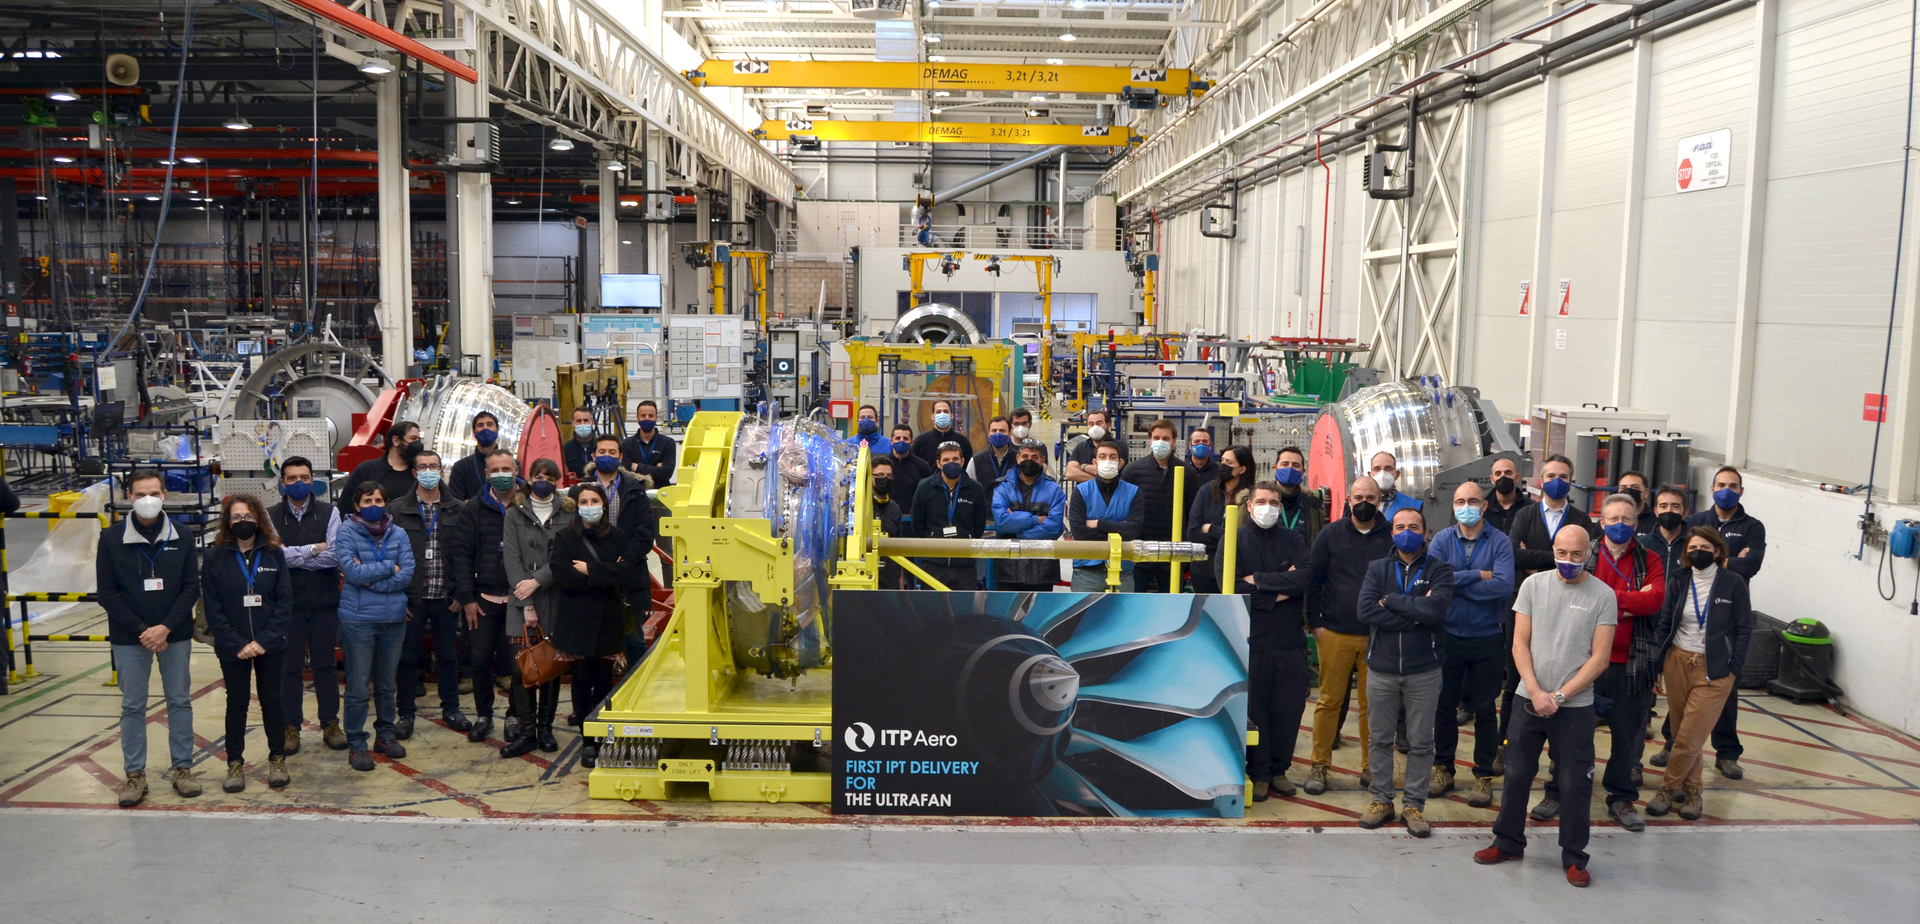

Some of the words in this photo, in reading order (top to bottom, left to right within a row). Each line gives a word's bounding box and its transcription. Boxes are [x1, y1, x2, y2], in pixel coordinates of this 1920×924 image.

[923, 68, 968, 79] DEMAG
[1006, 70, 1027, 82] 3,2t
[1029, 70, 1036, 83] /
[1038, 71, 1059, 82] 3,2t
[928, 126, 963, 135] DEMAG
[990, 128, 1006, 137] 3,2t
[1015, 128, 1030, 137] 3,2t
[1678, 167, 1692, 180] STOP
[881, 730, 912, 746] ITP
[913, 730, 958, 746] Aero
[846, 760, 882, 773] FIRST
[886, 761, 906, 773] IPT
[910, 761, 979, 774] DELIVERY
[846, 776, 876, 790] FOR
[845, 793, 871, 806] THE
[875, 793, 952, 807] ULTRAFAN
